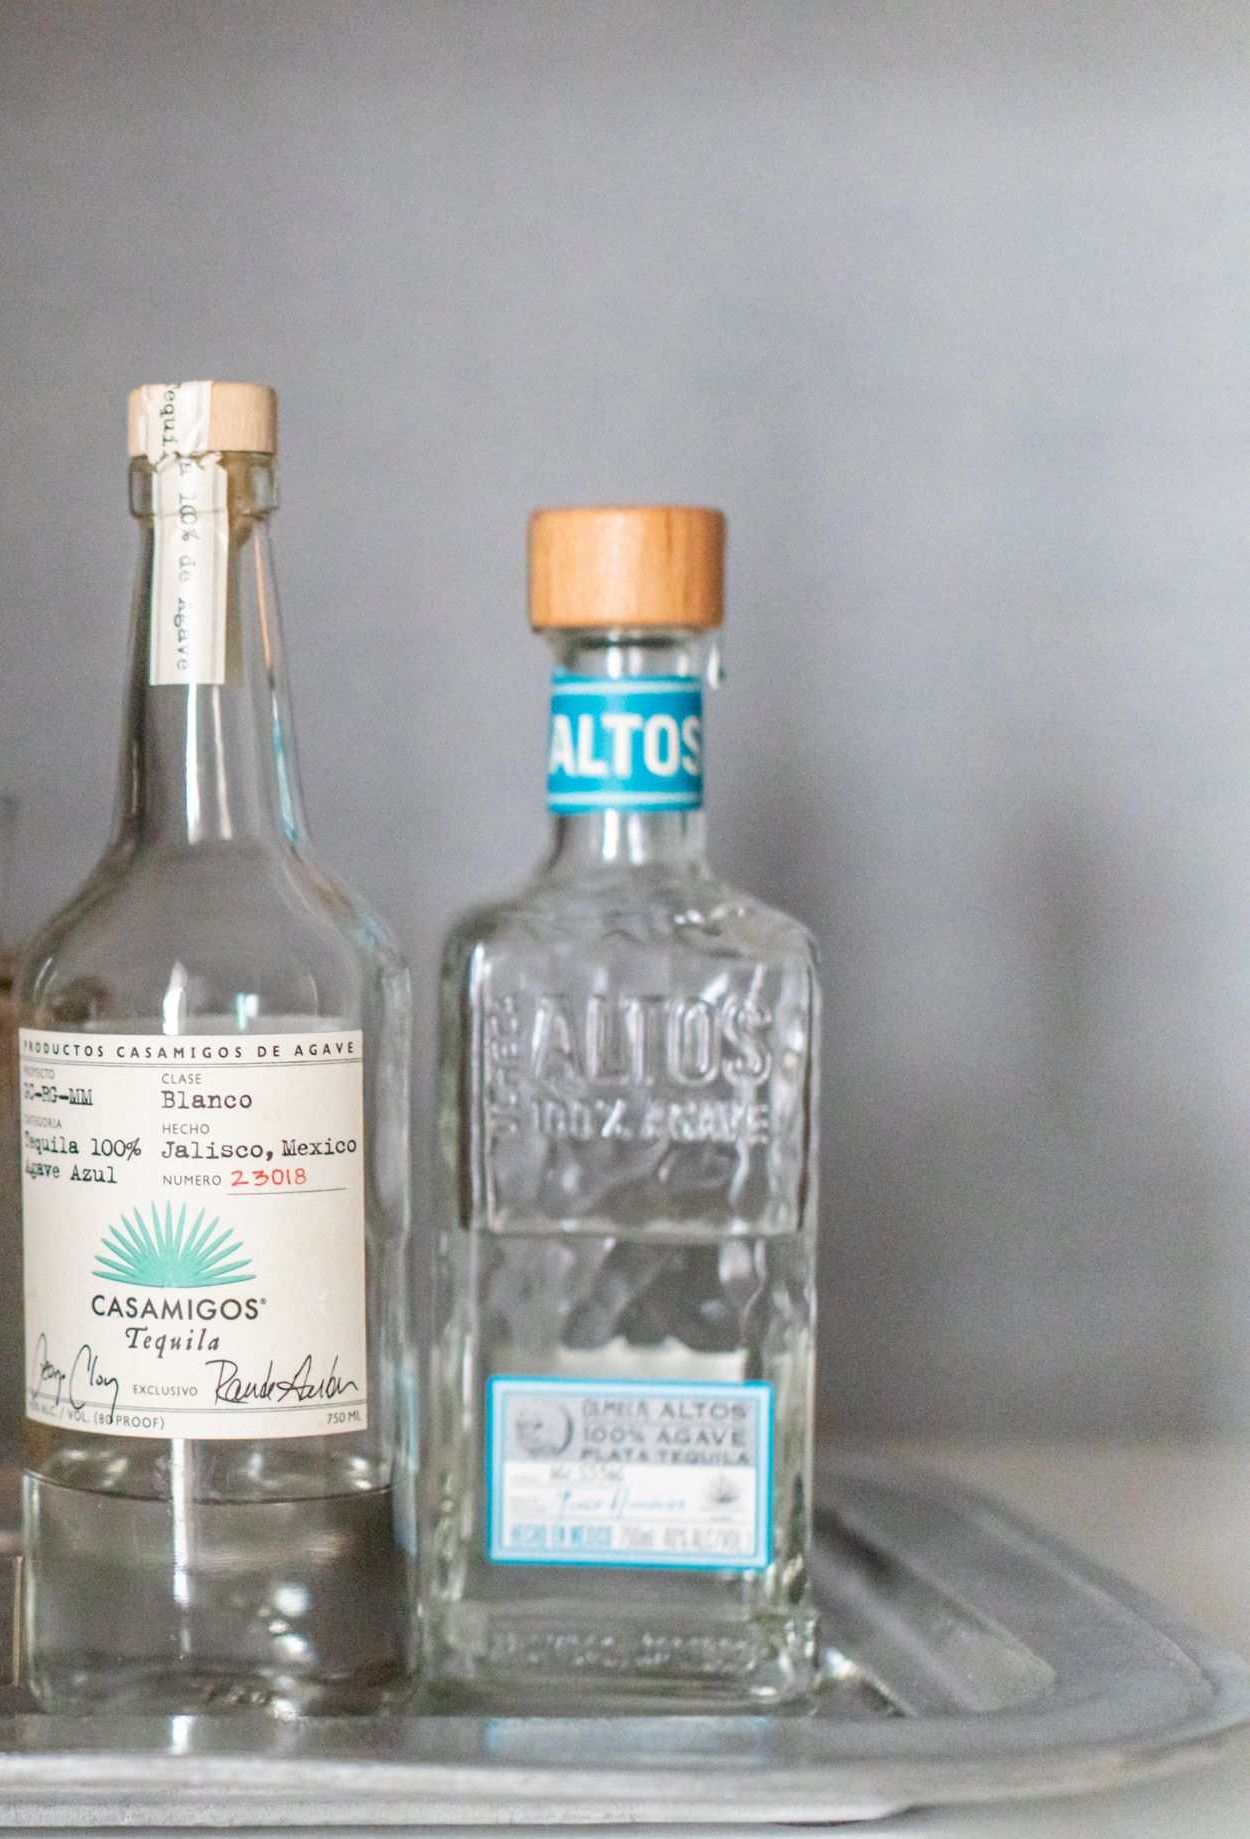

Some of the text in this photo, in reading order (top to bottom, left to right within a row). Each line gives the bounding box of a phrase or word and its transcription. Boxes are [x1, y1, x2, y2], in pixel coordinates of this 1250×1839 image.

[179, 555, 197, 583] de
[551, 713, 700, 779] ALTOS
[116, 1046, 243, 1059] CASAMIGOS
[257, 1046, 281, 1058] DE
[294, 1042, 355, 1056] AGAVE
[161, 1073, 201, 1084] CLASE
[161, 1090, 252, 1109] Blanco
[162, 1123, 210, 1135] HECHO
[91, 1137, 142, 1161] 100%
[161, 1138, 357, 1161] Jalisco, Mexico
[70, 1164, 118, 1184] Azul
[162, 1167, 307, 1186] NUMERO 23018
[125, 1326, 220, 1359] Tequila
[133, 1384, 198, 1397] EXCLUSIVO
[327, 1411, 362, 1424] 750 ML
[660, 1402, 747, 1420] ALTOS
[116, 1415, 164, 1431] PROOF)
[657, 1428, 747, 1447] AGAVE
